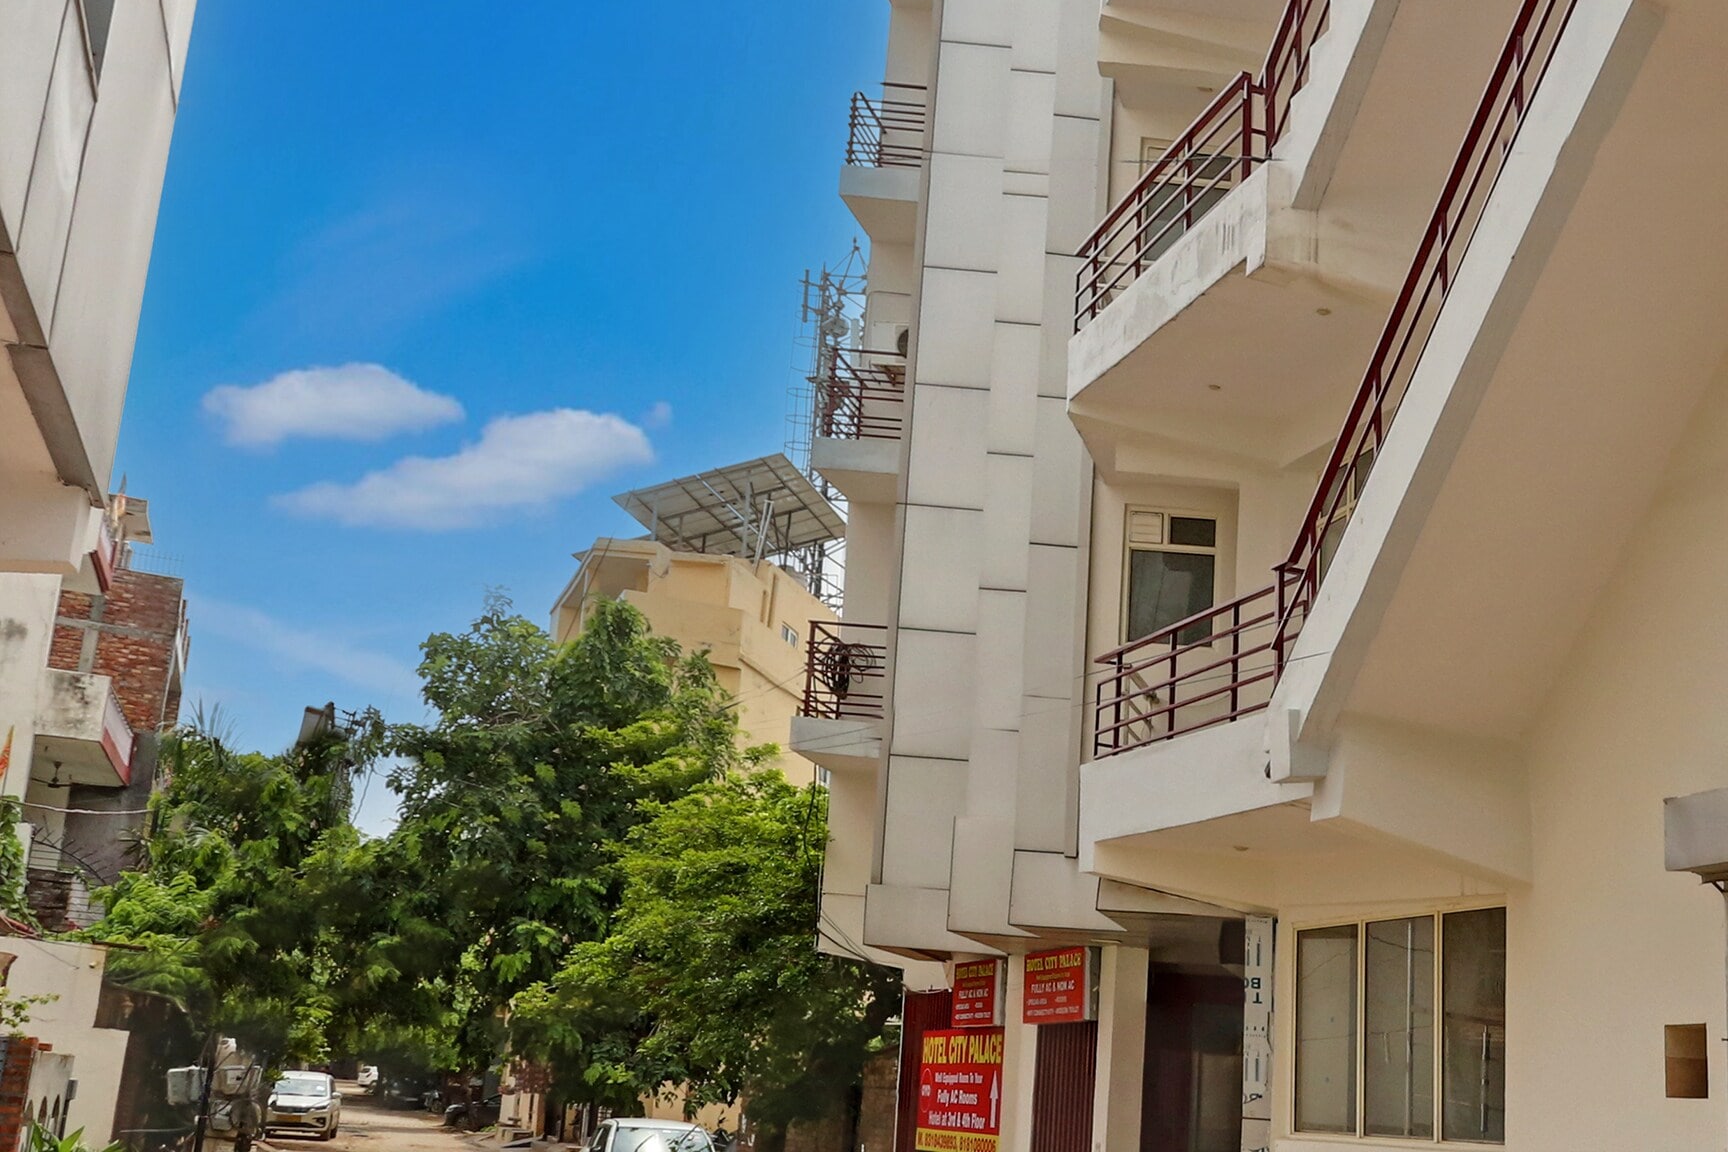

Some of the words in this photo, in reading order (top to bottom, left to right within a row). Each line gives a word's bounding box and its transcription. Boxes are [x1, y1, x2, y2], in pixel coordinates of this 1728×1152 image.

[922, 1036, 947, 1064] HOTEL
[949, 1035, 968, 1064] CITY
[968, 1034, 1002, 1064] PALACE
